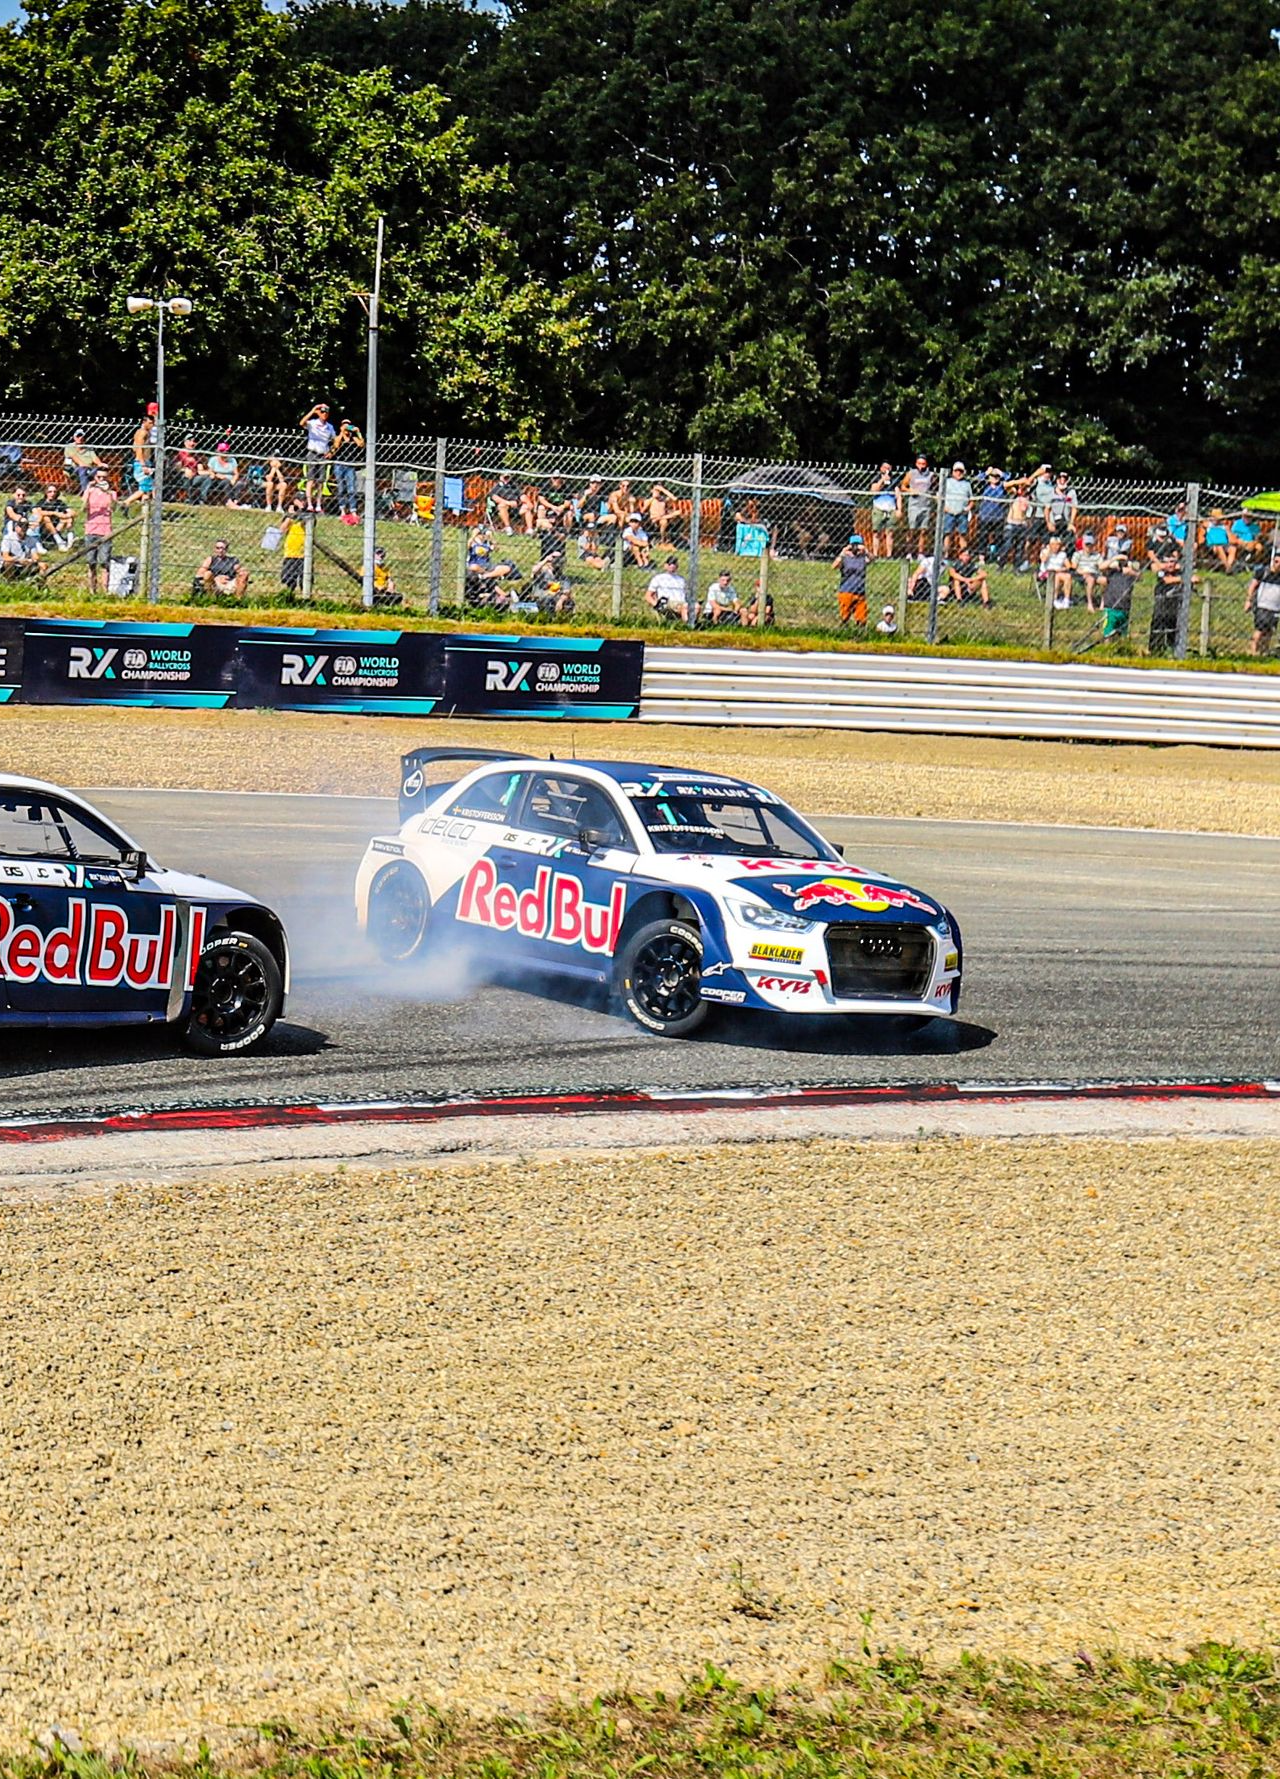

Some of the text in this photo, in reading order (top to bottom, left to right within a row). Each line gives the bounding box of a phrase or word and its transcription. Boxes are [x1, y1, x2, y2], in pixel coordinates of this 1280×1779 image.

[124, 651, 146, 667] FIA
[150, 649, 191, 662] WORLD
[360, 657, 399, 668] WORLD
[68, 647, 118, 679] RX
[149, 661, 190, 670] RALLYCROSS
[281, 654, 329, 685] RX
[334, 657, 355, 674] FIA
[563, 663, 601, 675] WORLD
[121, 669, 190, 682] CHAMPIONSHIP
[359, 669, 398, 677] RALLYCROSS
[485, 660, 533, 691] RX
[538, 664, 559, 680] FIA
[562, 674, 600, 683] RALLYCROSS
[332, 676, 399, 687] CHAMPIONSHIP
[535, 682, 600, 693] CHAMPIONSHIP
[620, 782, 669, 797] RX
[724, 788, 750, 798] LIVE
[656, 803, 678, 825] 1
[647, 824, 725, 835] KRISTOFFERSSON
[457, 859, 626, 956] Red Bul
[87, 904, 207, 989] Bull
[756, 976, 813, 994] KYB
[701, 987, 747, 998] COOPER
[220, 1024, 266, 1050] COOPER
